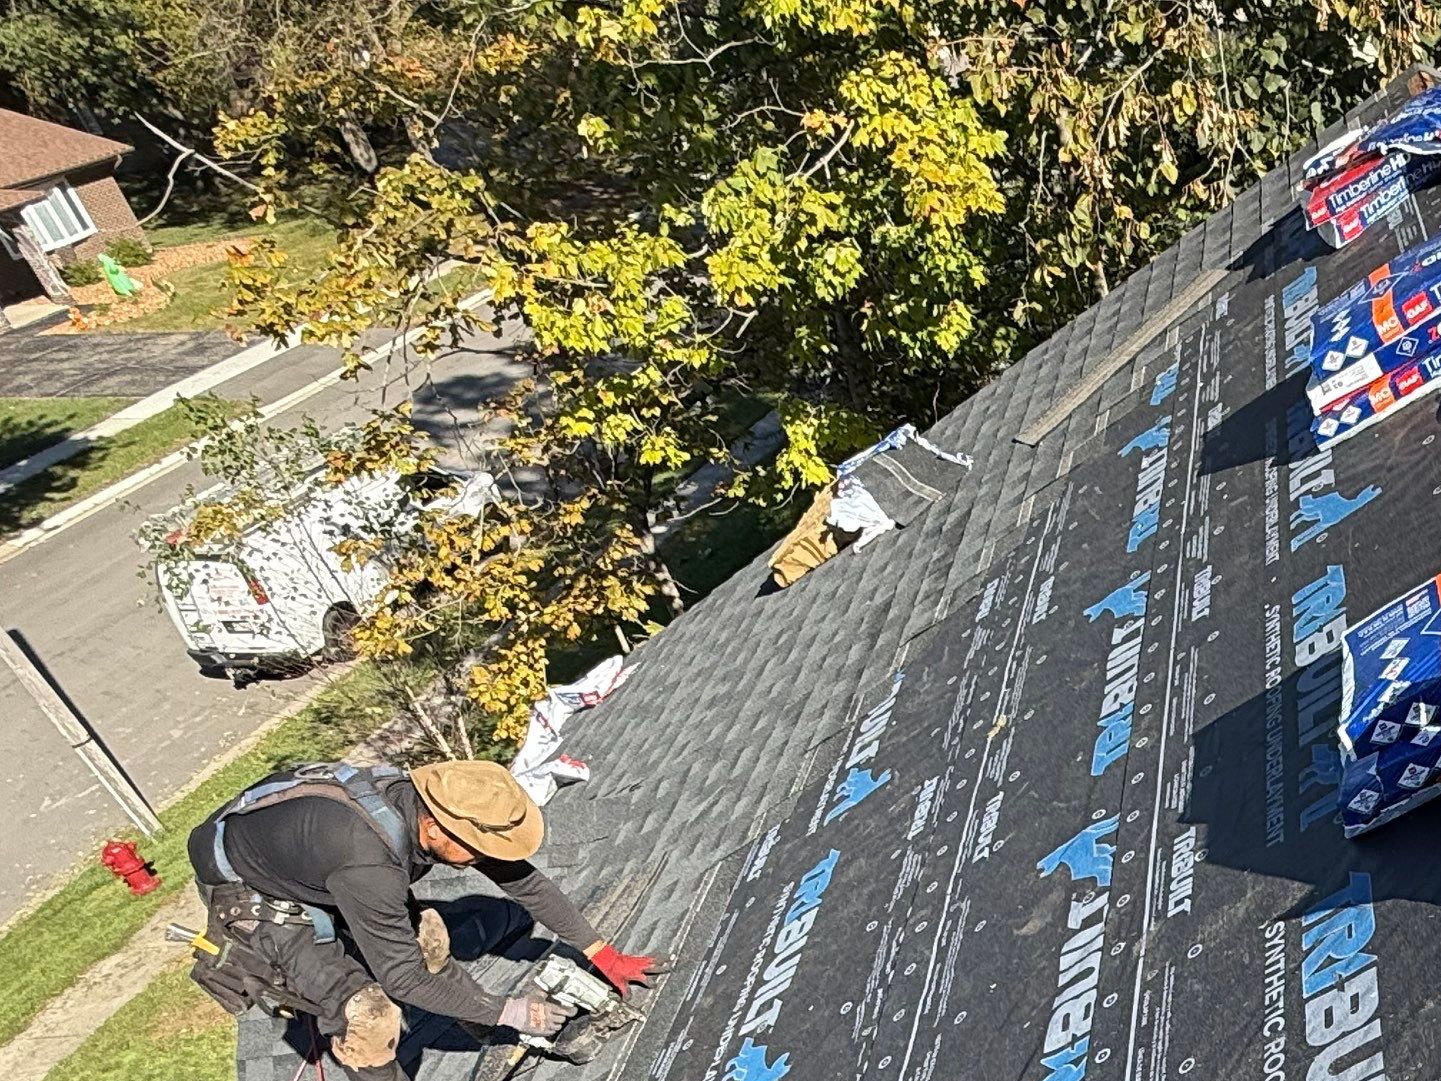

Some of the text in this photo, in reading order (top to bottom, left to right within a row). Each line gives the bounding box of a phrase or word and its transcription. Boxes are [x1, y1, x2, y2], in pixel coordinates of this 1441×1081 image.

[1329, 163, 1391, 209] Timberline
[1406, 300, 1429, 319] GAF
[1090, 616, 1146, 777] TRIBUILT
[1265, 605, 1285, 848] SYNTHETIC ROOFING UNDERLAYMENT
[1166, 826, 1197, 918] TRIBUILT
[739, 847, 841, 1037] TRIBUILT
[1260, 920, 1286, 1036] SYNTHETIC
